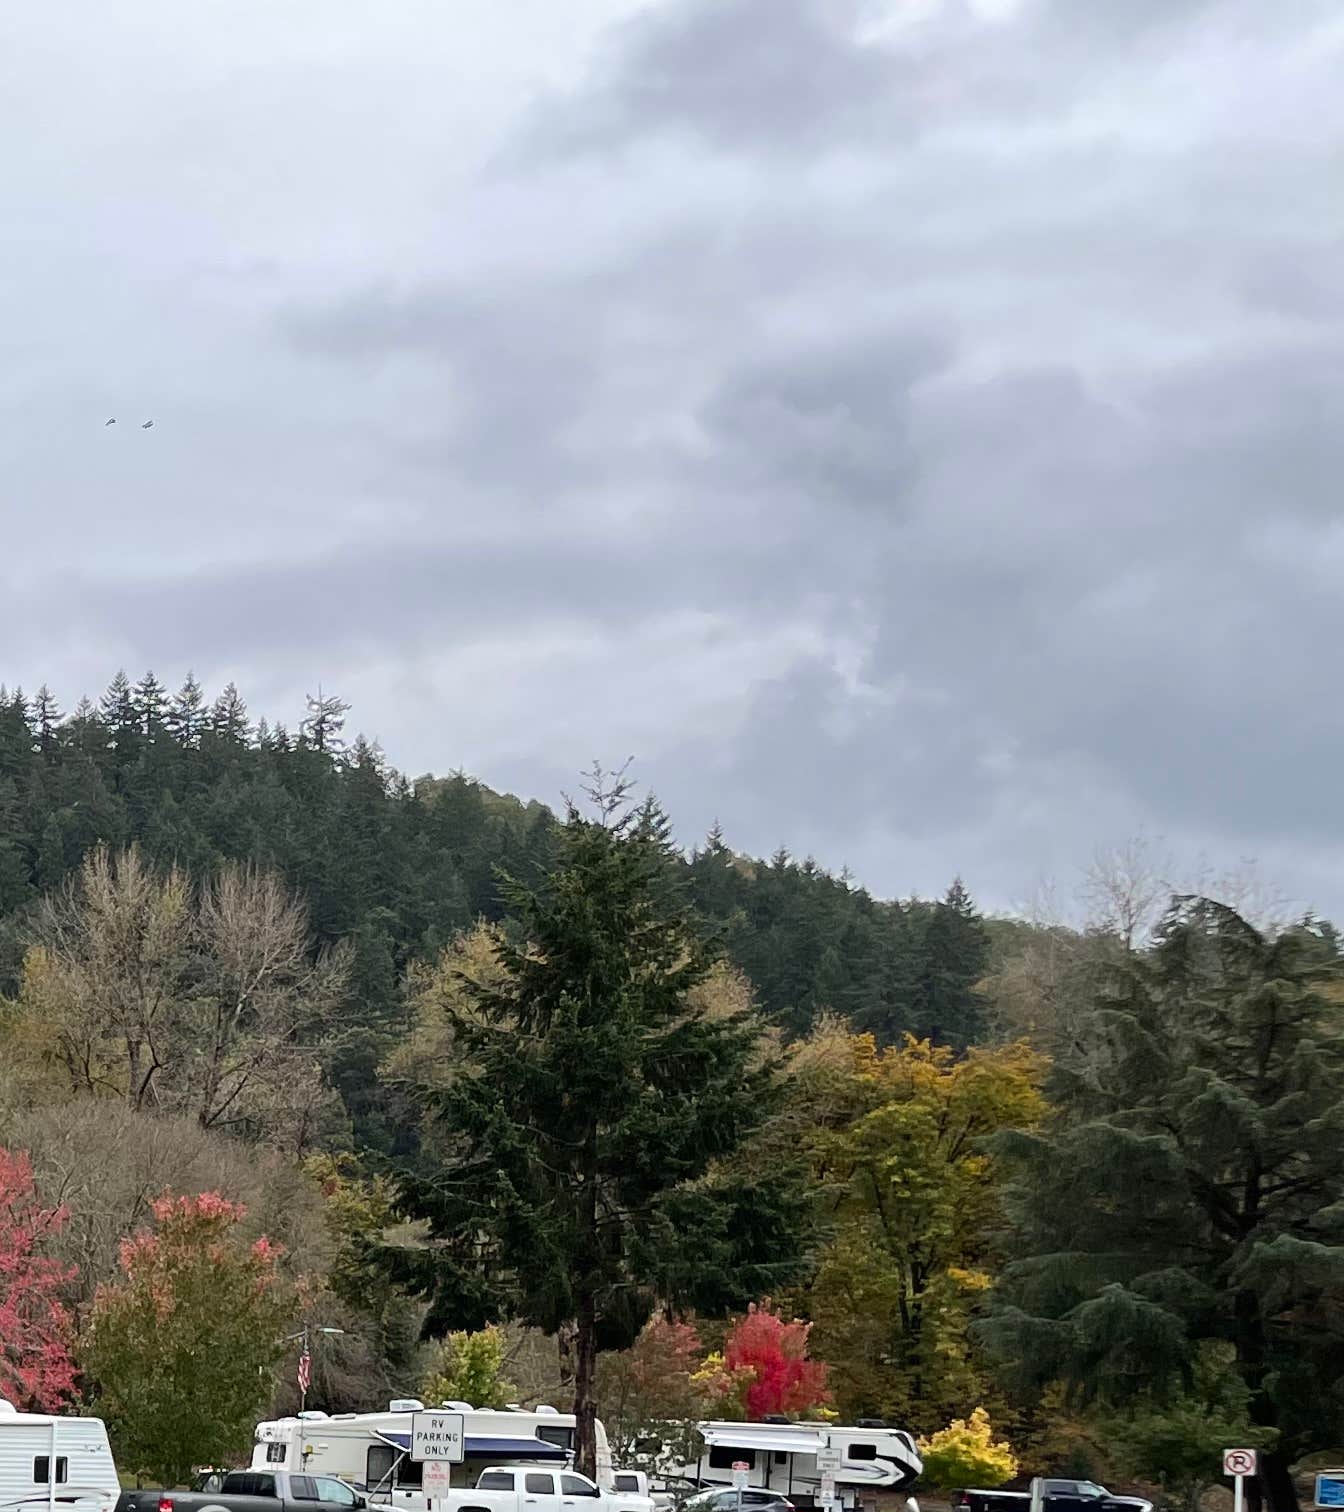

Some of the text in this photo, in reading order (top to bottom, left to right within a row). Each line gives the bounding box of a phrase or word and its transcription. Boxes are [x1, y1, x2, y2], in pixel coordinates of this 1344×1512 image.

[431, 1419, 444, 1429] RV
[416, 1432, 459, 1442] PARKING
[425, 1446, 449, 1456] ONLY
